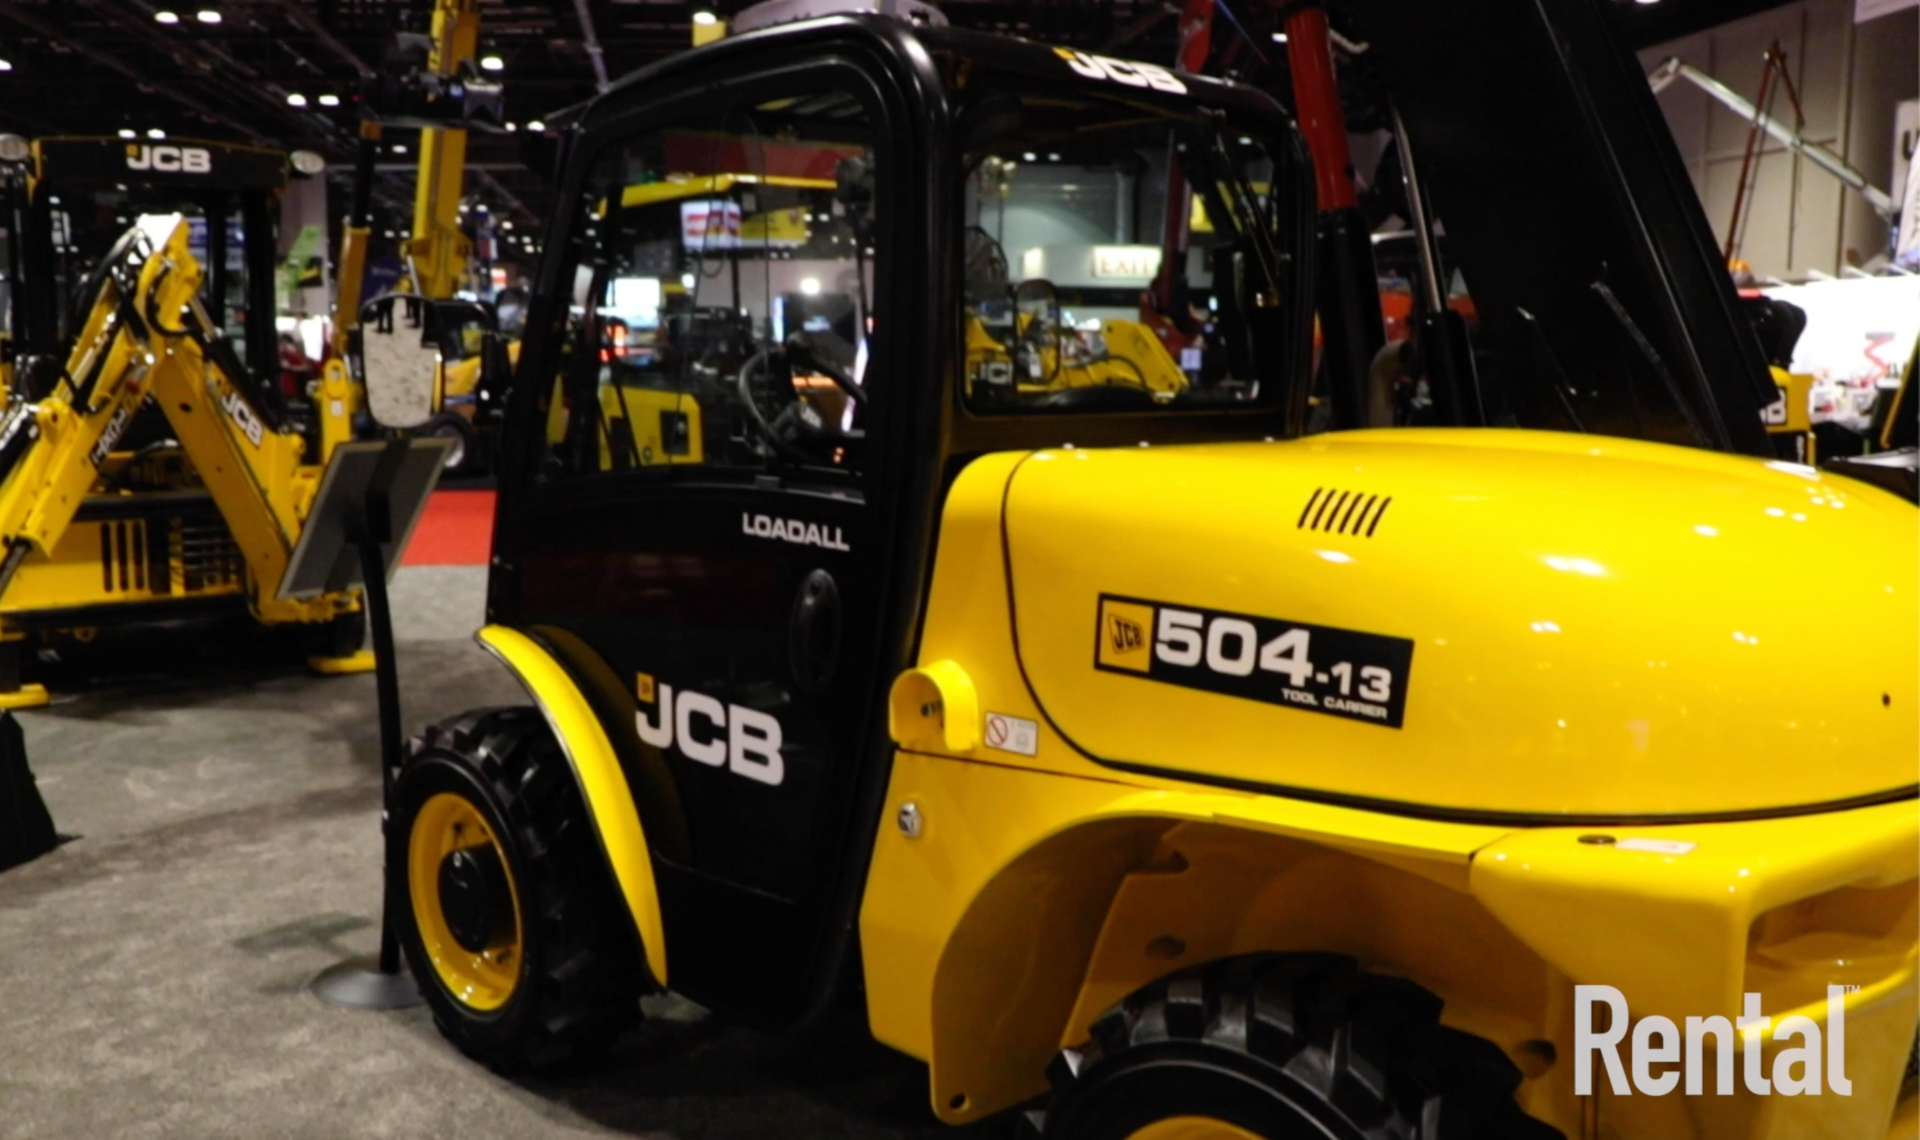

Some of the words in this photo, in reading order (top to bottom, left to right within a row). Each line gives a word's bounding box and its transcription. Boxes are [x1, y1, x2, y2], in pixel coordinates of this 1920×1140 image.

[1066, 50, 1188, 95] JCB
[126, 144, 212, 173] JCB
[971, 361, 1013, 384] JC
[221, 391, 264, 448] JCB
[742, 511, 850, 552] LOADALL
[1112, 618, 1143, 650] JCB
[1155, 607, 1393, 703] 504-13
[1281, 688, 1319, 706] TOOL
[1323, 695, 1388, 720] CARRIER
[635, 682, 785, 787] JCB
